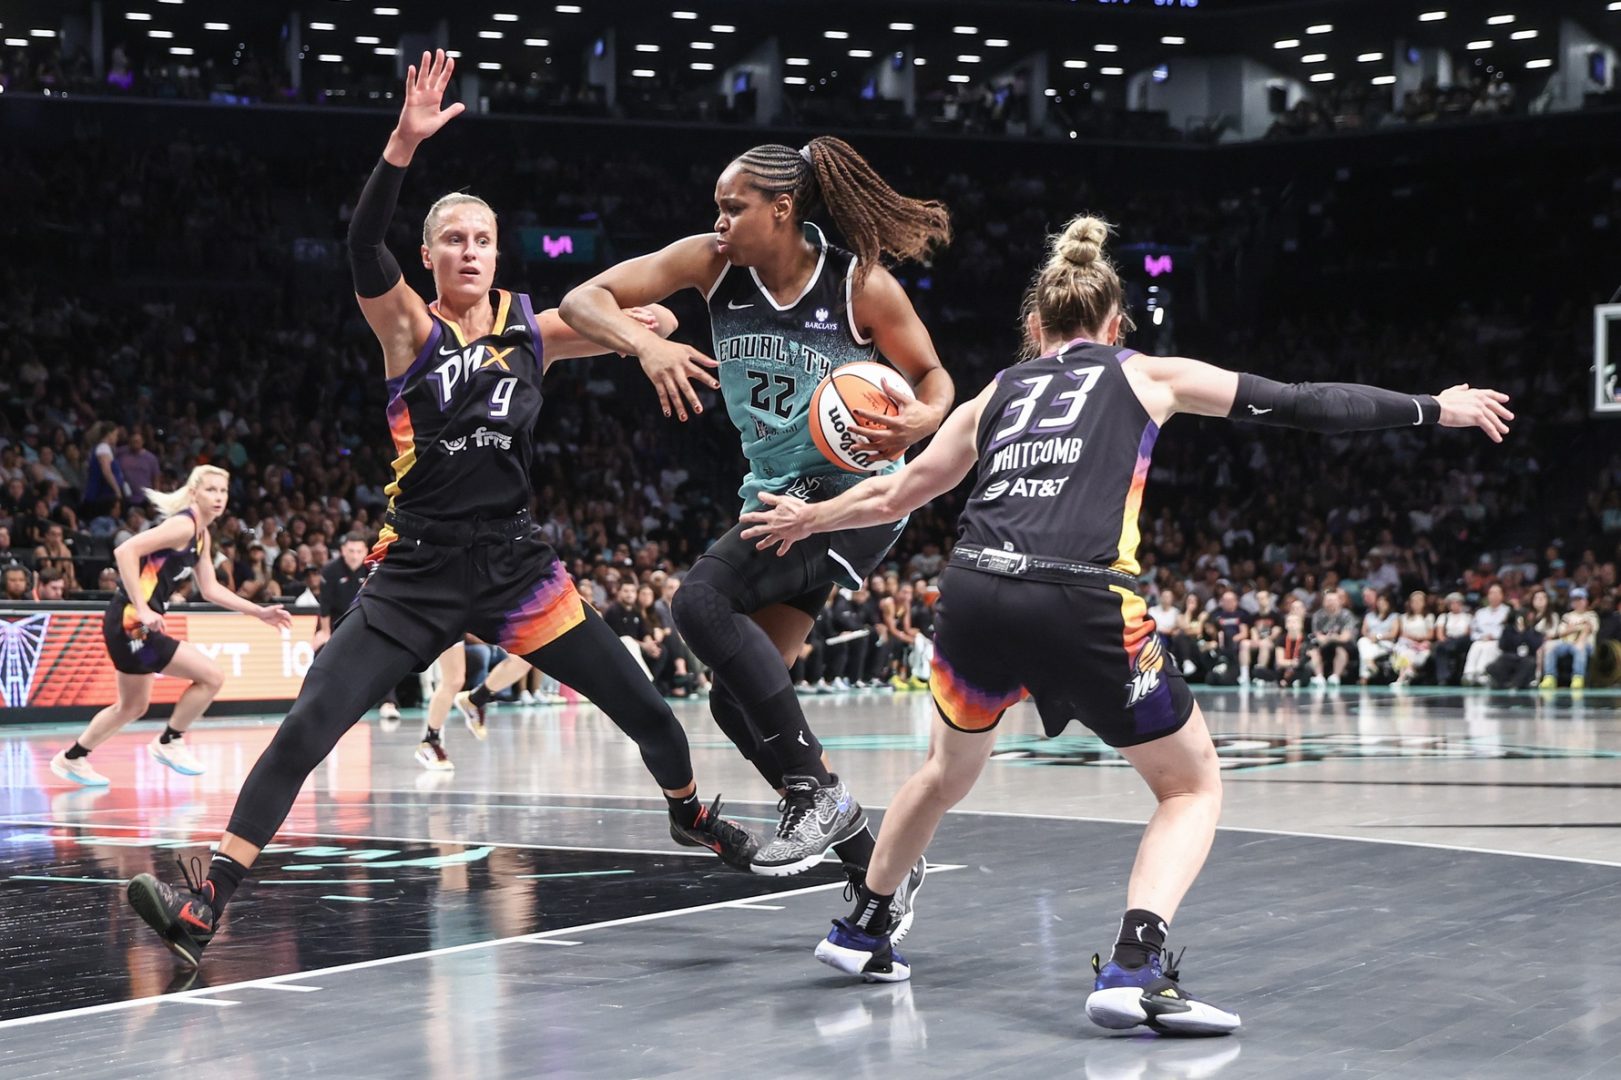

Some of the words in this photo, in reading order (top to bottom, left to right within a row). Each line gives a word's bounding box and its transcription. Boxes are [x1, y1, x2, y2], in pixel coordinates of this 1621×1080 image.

[804, 321, 838, 331] BARCLAYS
[490, 378, 518, 418] 9
[746, 369, 796, 421] 22
[990, 365, 1105, 447] 33
[828, 405, 873, 468] Wlson
[990, 437, 1083, 475] WHITCOMB
[1009, 476, 1069, 498] AT&T
